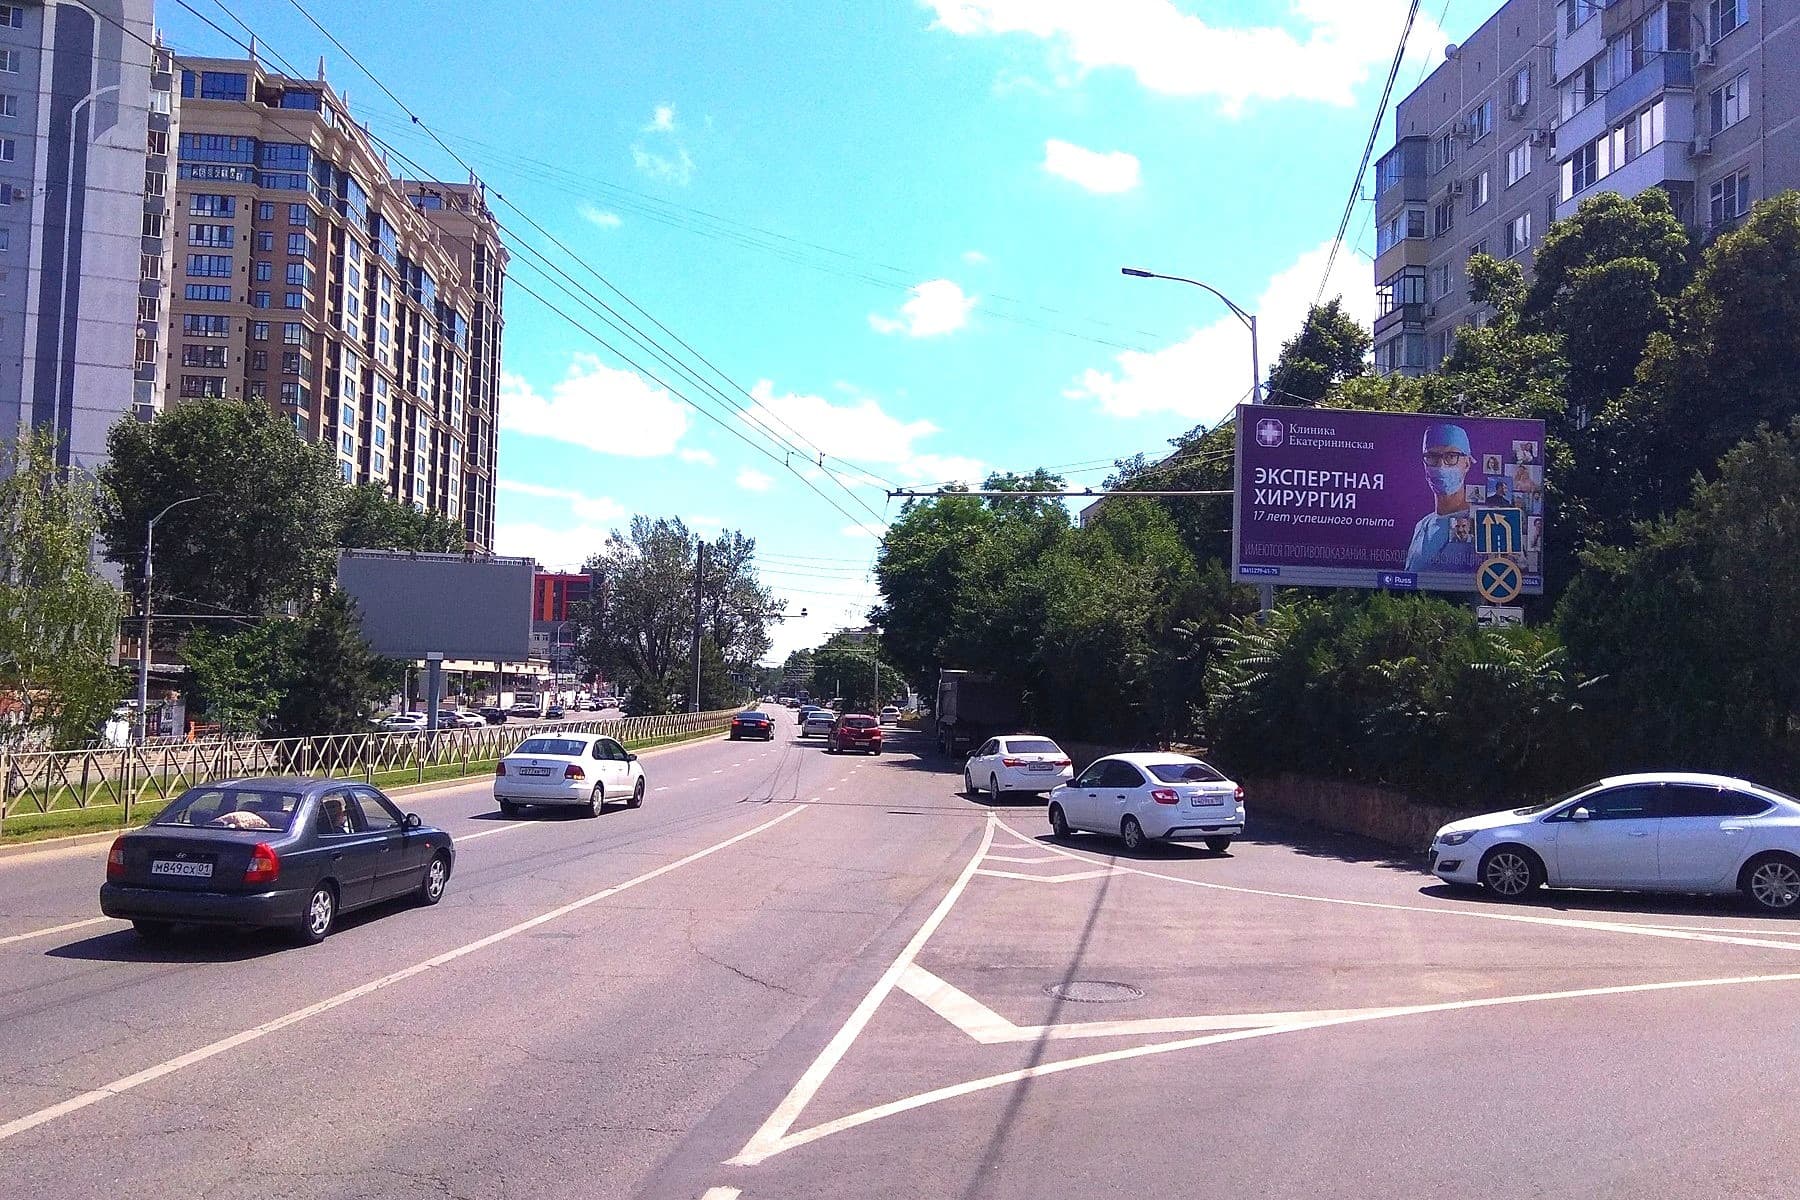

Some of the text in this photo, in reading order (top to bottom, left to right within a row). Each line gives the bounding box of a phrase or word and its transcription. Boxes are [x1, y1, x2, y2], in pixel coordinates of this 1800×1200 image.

[1289, 423, 1336, 436] Клиника
[1289, 435, 1375, 449] Екатерининская
[1254, 467, 1384, 490] ЭКСПЕРТНАЯ
[1254, 488, 1356, 509] ХИРУРГИЯ
[1253, 510, 1395, 528] 17 лет успешного опыта
[1246, 543, 1284, 557] ИМЕЮТСЯ
[1394, 576, 1412, 584] Russ
